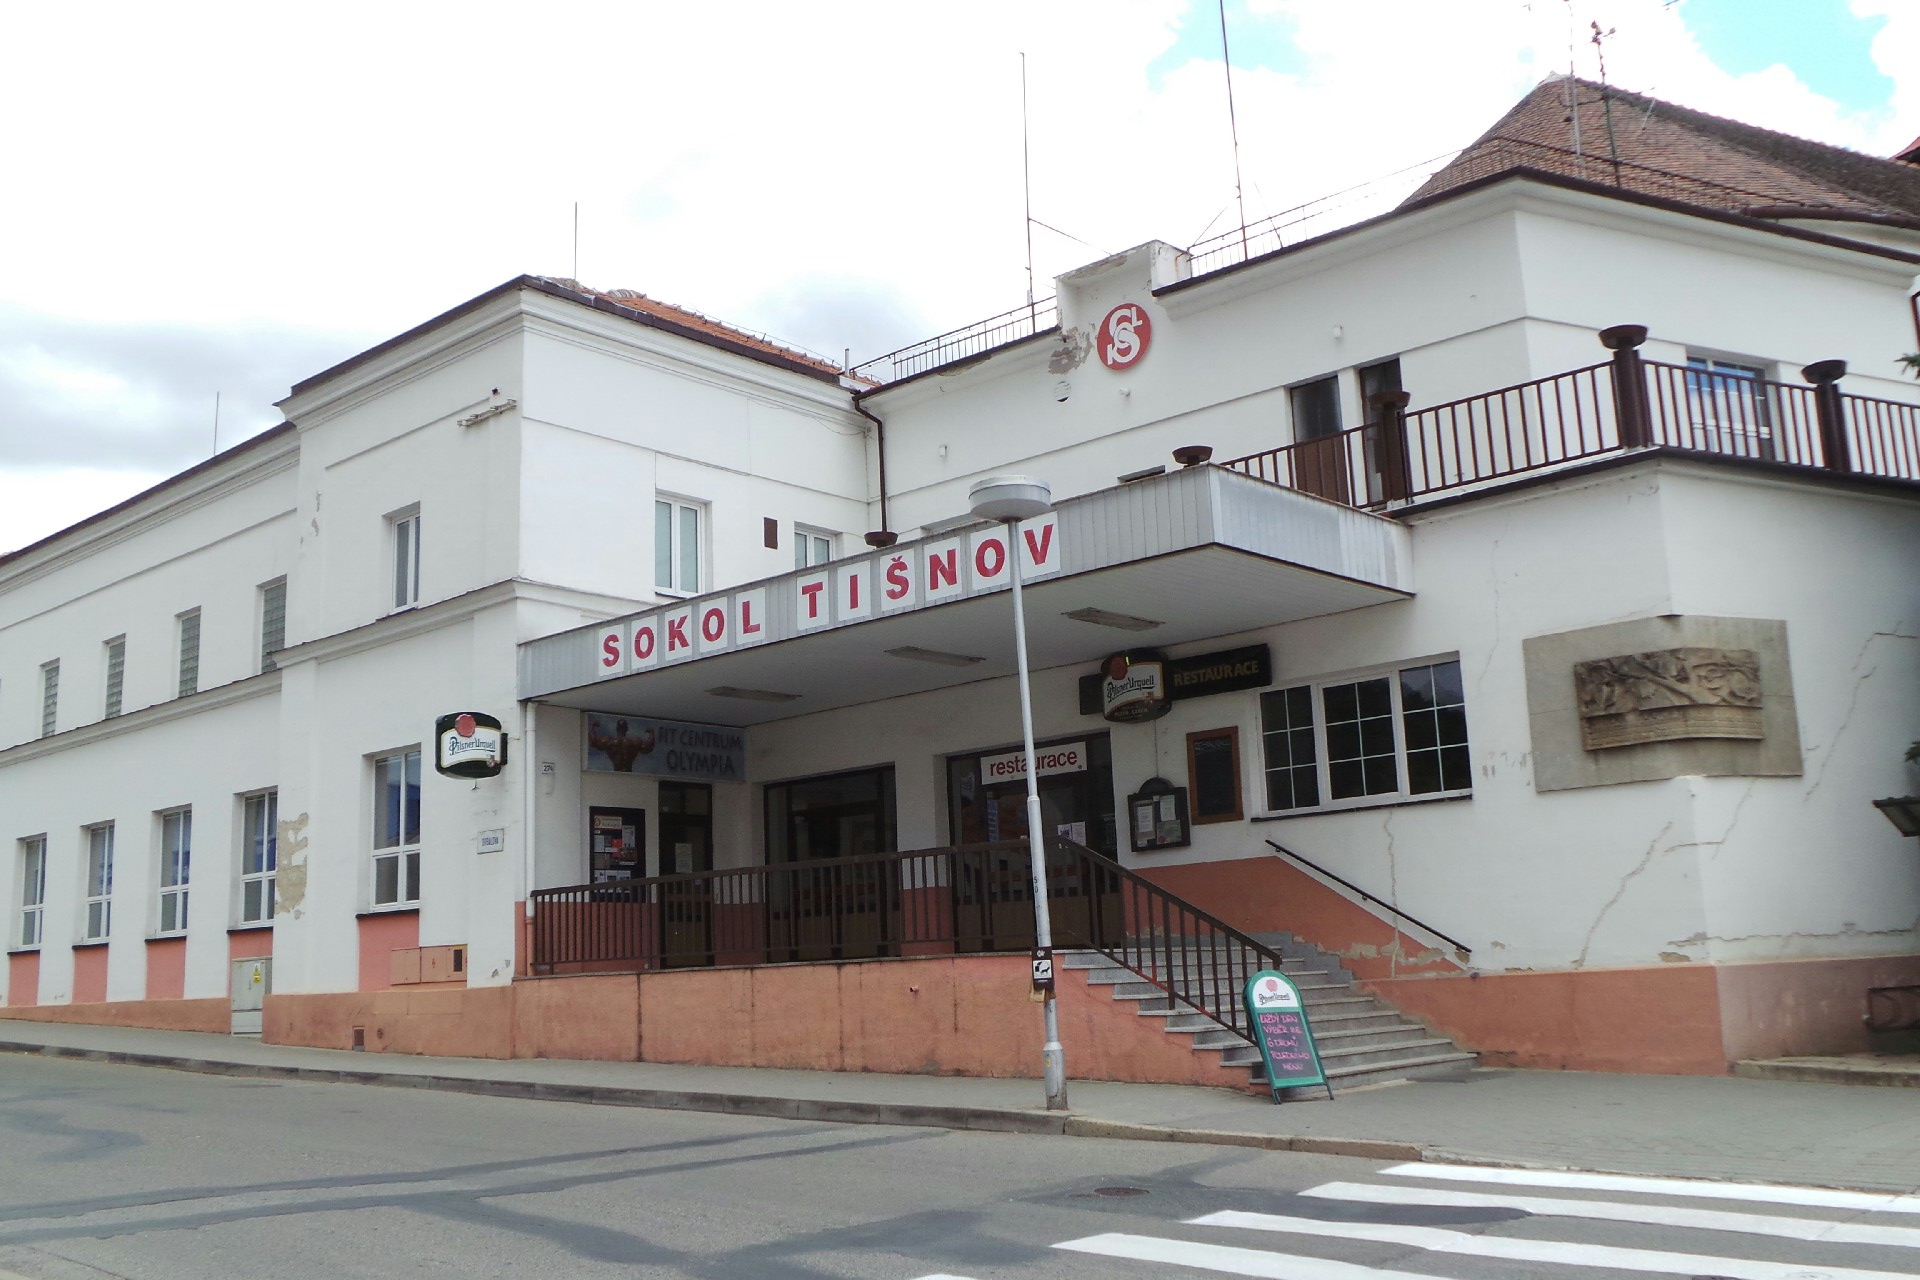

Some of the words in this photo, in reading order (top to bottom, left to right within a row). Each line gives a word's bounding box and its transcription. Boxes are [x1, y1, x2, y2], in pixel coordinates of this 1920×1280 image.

[602, 601, 760, 667] SOKOL
[801, 523, 1053, 618] TIŠNOV
[1173, 660, 1259, 687] RESTAURACE
[1107, 682, 1128, 702] Pilsner
[1128, 675, 1154, 690] Urquell
[448, 736, 475, 756] Pilsner
[475, 738, 496, 752] Urquell
[657, 727, 678, 745] FIT
[680, 729, 743, 752] CENTRUM
[666, 749, 735, 775] OLYMPIA
[989, 750, 1078, 777] restaurace
